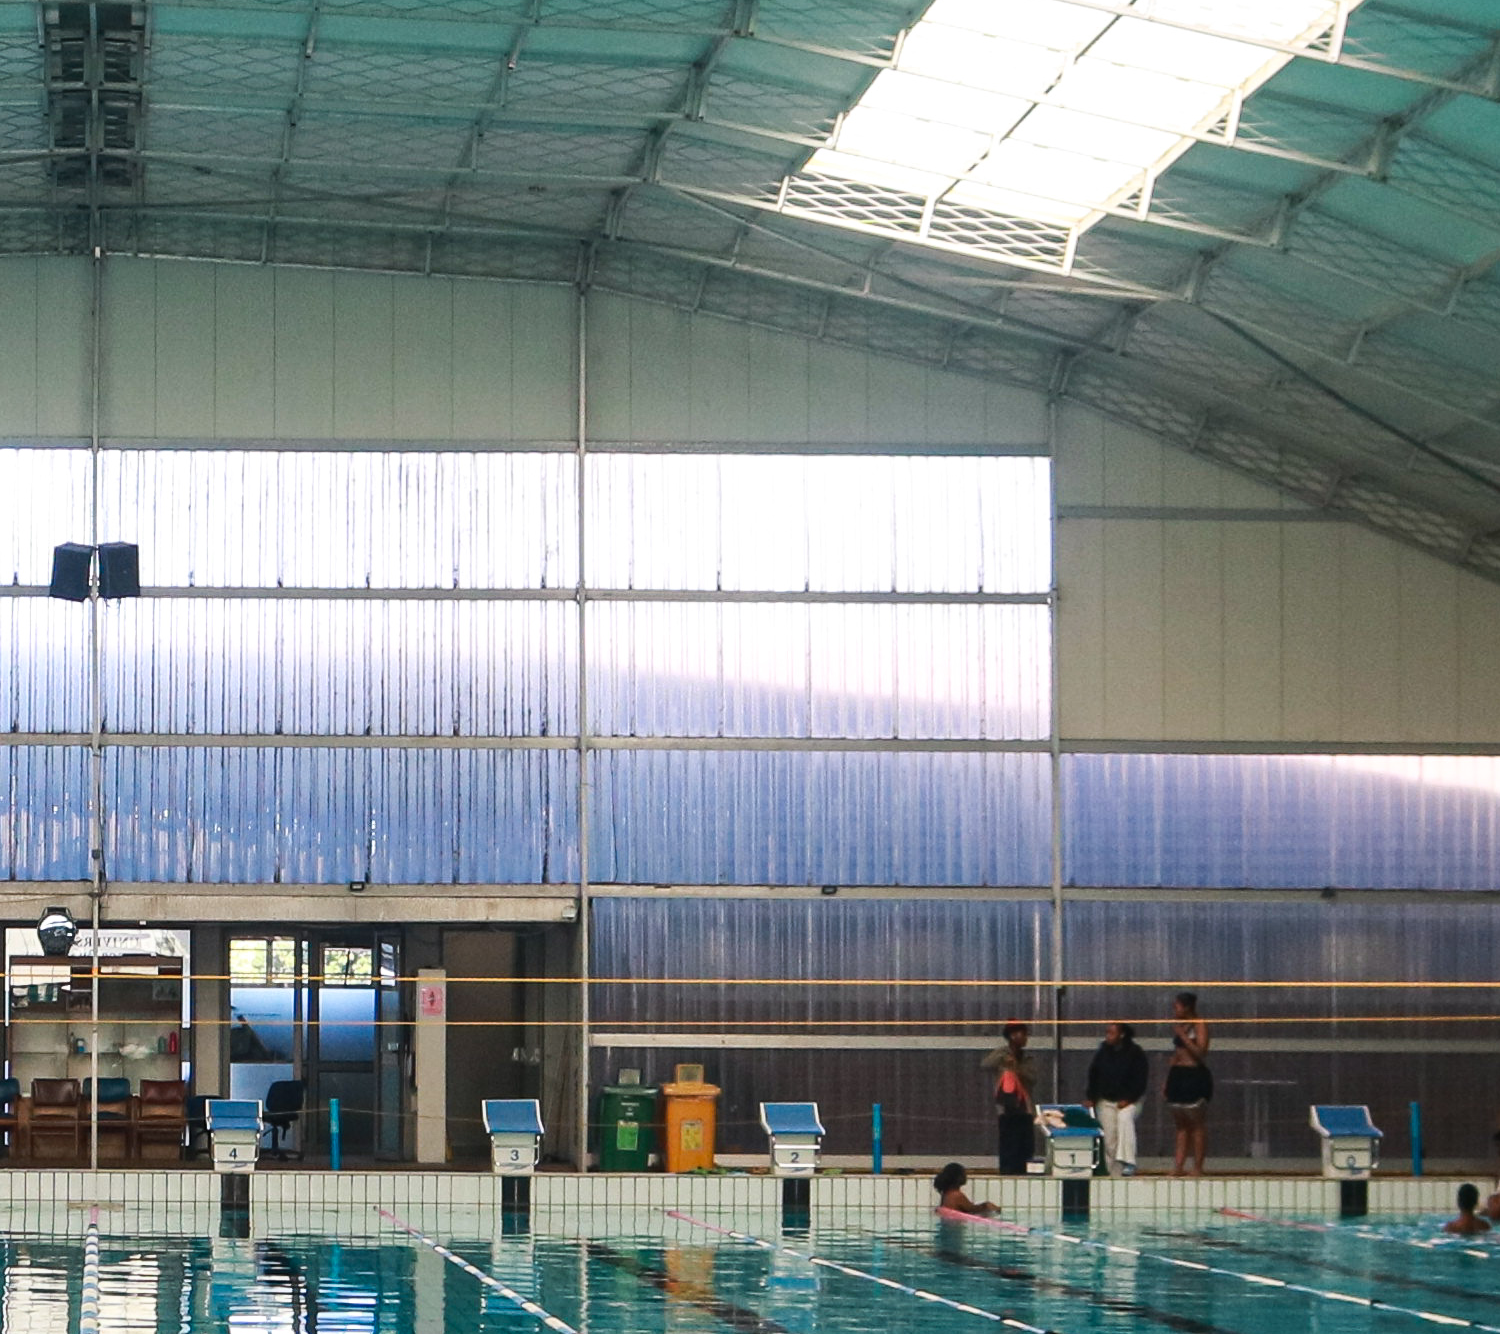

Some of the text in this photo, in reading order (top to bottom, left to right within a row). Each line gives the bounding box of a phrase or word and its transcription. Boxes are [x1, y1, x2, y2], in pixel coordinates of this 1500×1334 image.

[229, 1148, 238, 1160] 4
[510, 1149, 519, 1161] 3
[790, 1152, 800, 1164] 2
